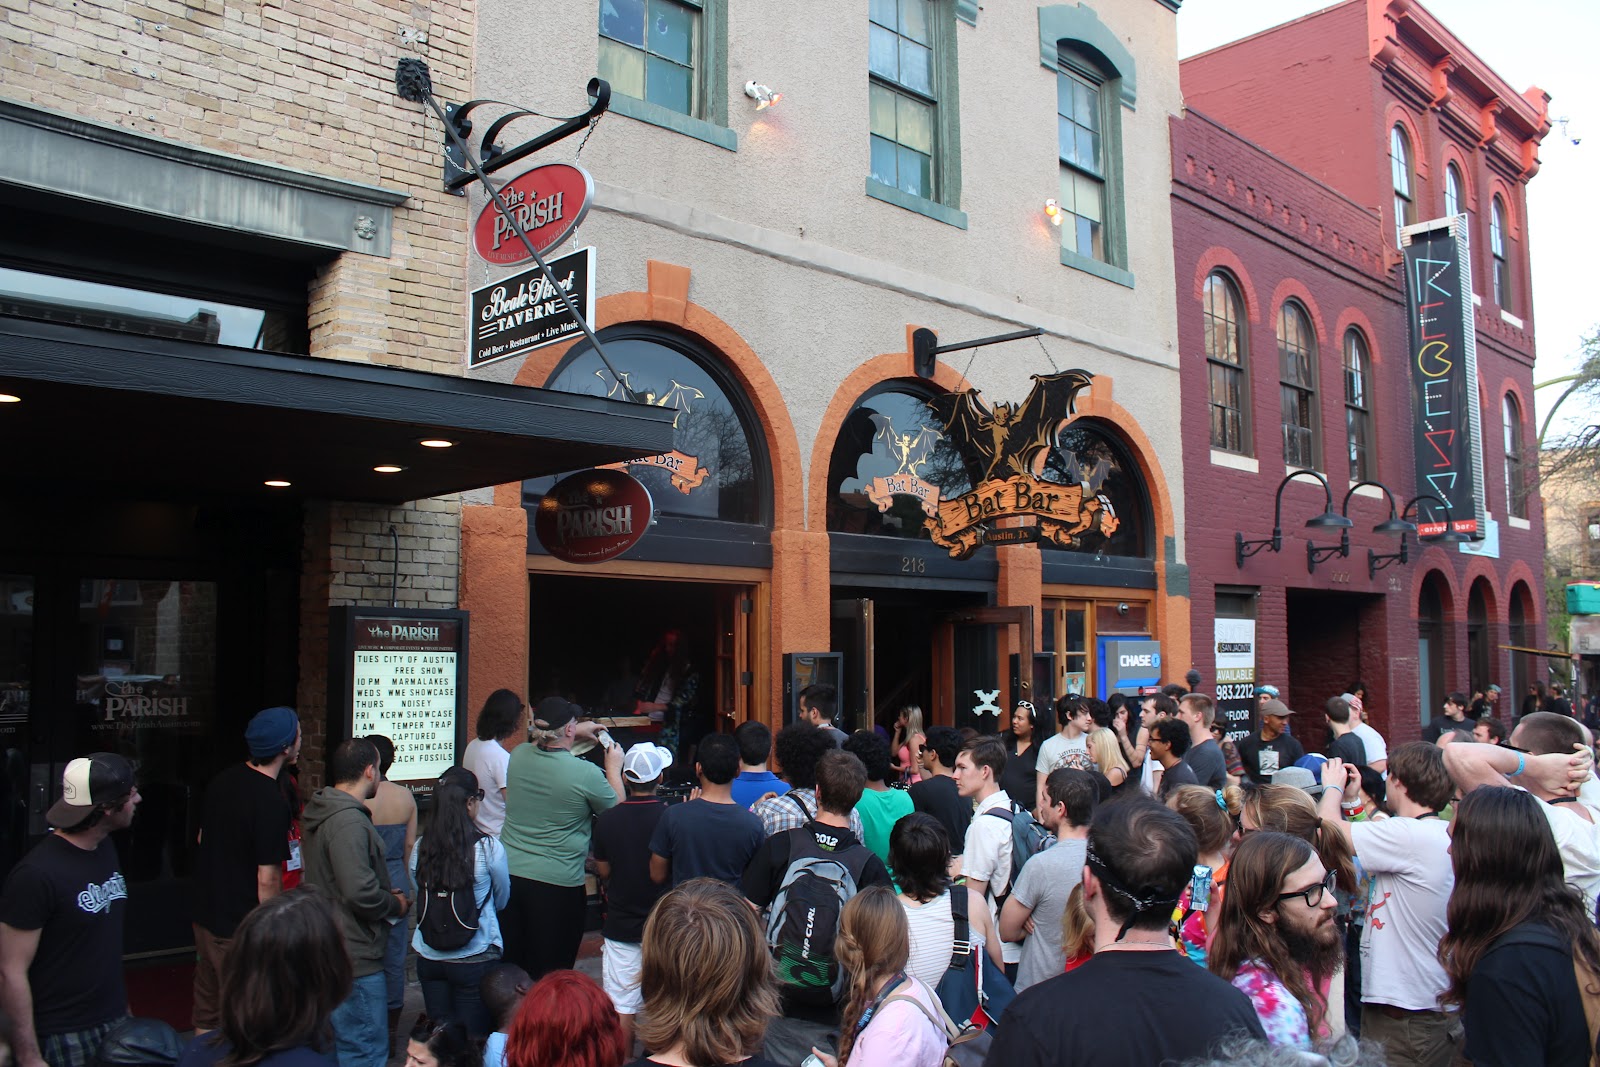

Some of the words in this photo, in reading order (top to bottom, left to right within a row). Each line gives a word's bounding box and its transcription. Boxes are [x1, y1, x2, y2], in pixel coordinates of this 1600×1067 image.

[492, 191, 564, 250] PARISH
[482, 284, 528, 321] Beale
[529, 266, 575, 305] Stret
[497, 301, 555, 332] TAVERN
[479, 347, 491, 358] Cold
[492, 344, 504, 355] Beer
[509, 333, 541, 349] Restaurant
[546, 327, 559, 338] Live
[560, 320, 579, 333] Music
[885, 478, 906, 493] Bat
[909, 478, 931, 498] Bar
[960, 489, 1009, 521] Bat
[1012, 482, 1061, 513] Bar
[557, 504, 633, 545] PARISH
[1455, 522, 1470, 530] bar
[902, 556, 925, 574] 218
[391, 621, 439, 642] PARISH
[358, 655, 379, 663] TUES
[384, 655, 403, 663] CITY
[408, 655, 418, 663] OF
[423, 656, 455, 664] AUSTIN
[1120, 654, 1151, 667] CHASE
[421, 667, 443, 675] SHOW
[1216, 668, 1253, 681] AVAILABLE
[392, 678, 449, 686] MARMALAKES
[410, 688, 454, 696] SHOWCASE
[1216, 683, 1254, 701] 983.2212
[104, 697, 188, 720] PARISH
[356, 700, 384, 708] THURS
[401, 699, 431, 708] NOISEY
[356, 711, 369, 719] FRI
[381, 711, 403, 719] KCRW
[407, 710, 453, 719] SHOWCASE
[1229, 709, 1250, 721] FLOOR
[392, 722, 424, 730] TEMPER
[430, 721, 452, 729] TRAP
[392, 732, 436, 741] CAPTURED
[409, 742, 453, 751] SHOWCASE
[393, 755, 415, 763] EACH
[420, 753, 453, 762] FOSSILS
[805, 907, 816, 938] CURL
[801, 937, 811, 959] RIP
